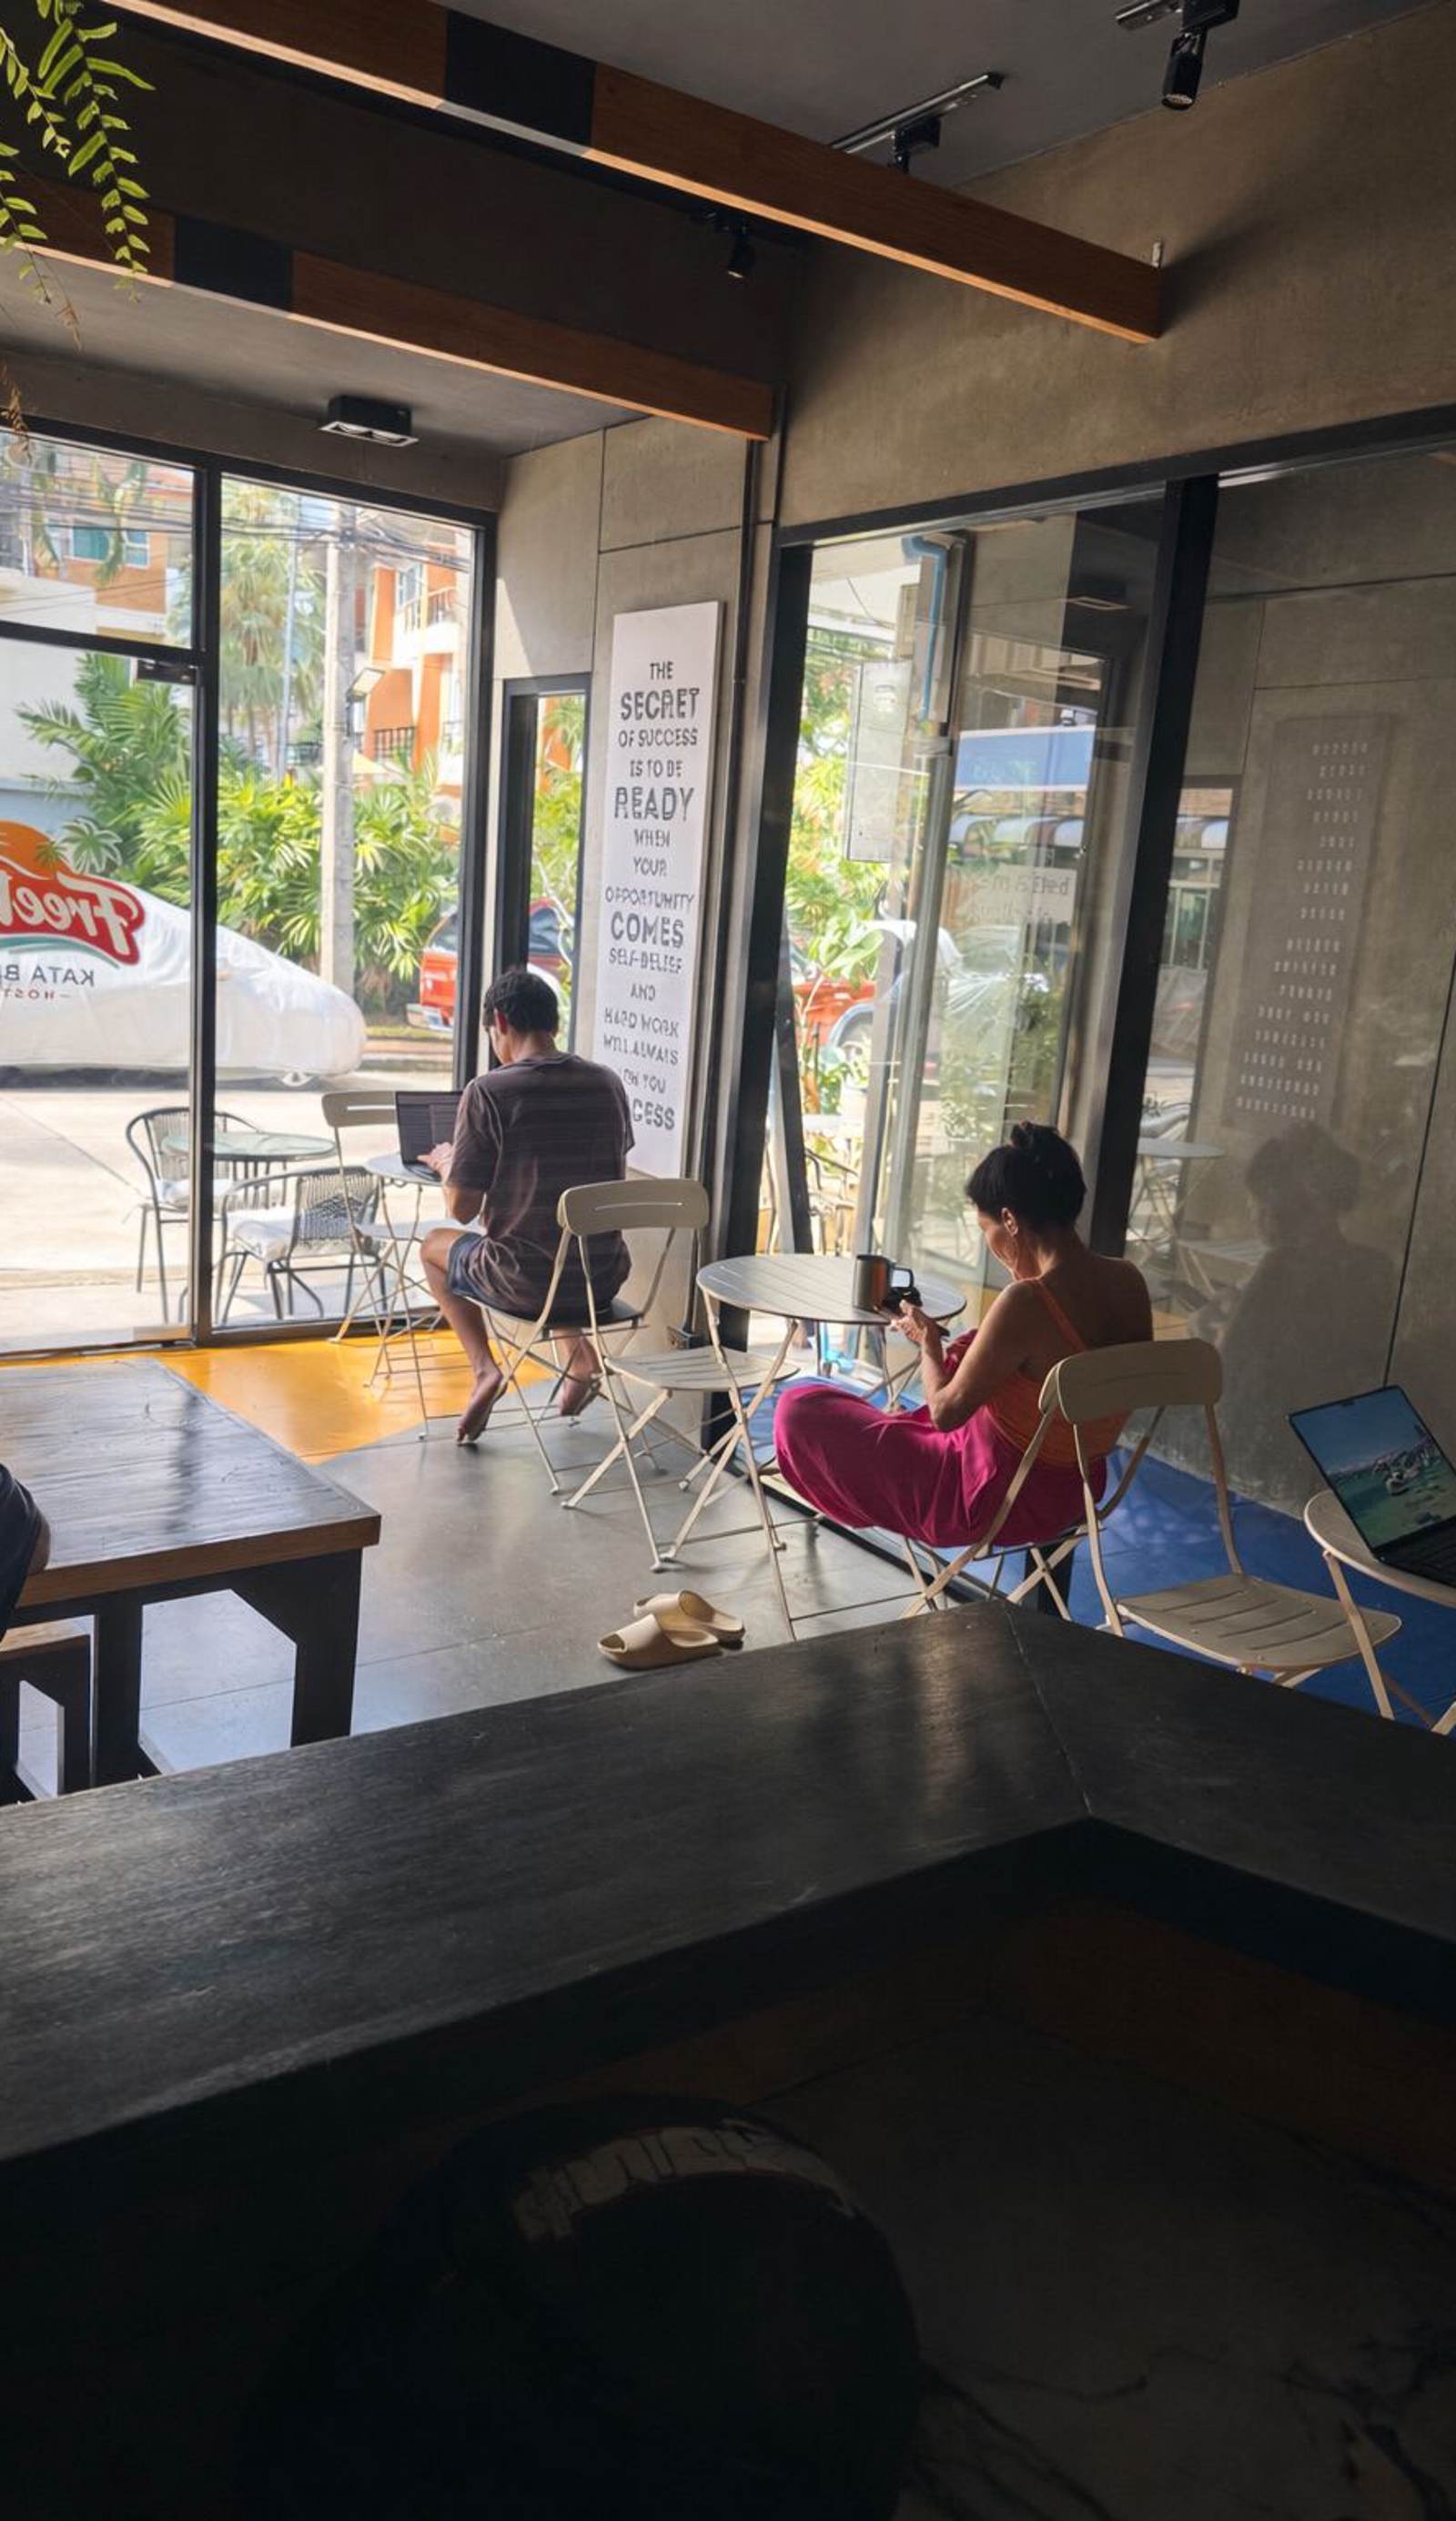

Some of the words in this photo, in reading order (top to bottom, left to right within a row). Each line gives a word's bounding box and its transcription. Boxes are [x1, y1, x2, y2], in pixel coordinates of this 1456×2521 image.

[650, 661, 673, 680] THE
[621, 687, 700, 721] SECRET
[619, 729, 634, 748] OF
[638, 727, 698, 746] SUCCESS
[630, 759, 642, 777] IS
[647, 759, 663, 777] TO
[614, 786, 694, 822] READY
[634, 829, 671, 847] WHEN
[633, 857, 667, 876] YOUR
[605, 886, 695, 913] OPPORTUNITY
[611, 911, 684, 948] COMES
[631, 983, 656, 1001] AND
[604, 1007, 637, 1029] HARD
[641, 1013, 680, 1038] WORK
[603, 1034, 628, 1055] WILL
[632, 1040, 679, 1066] ALWAYS
[642, 1074, 666, 1094] YOU
[632, 1098, 675, 1130] CESS
